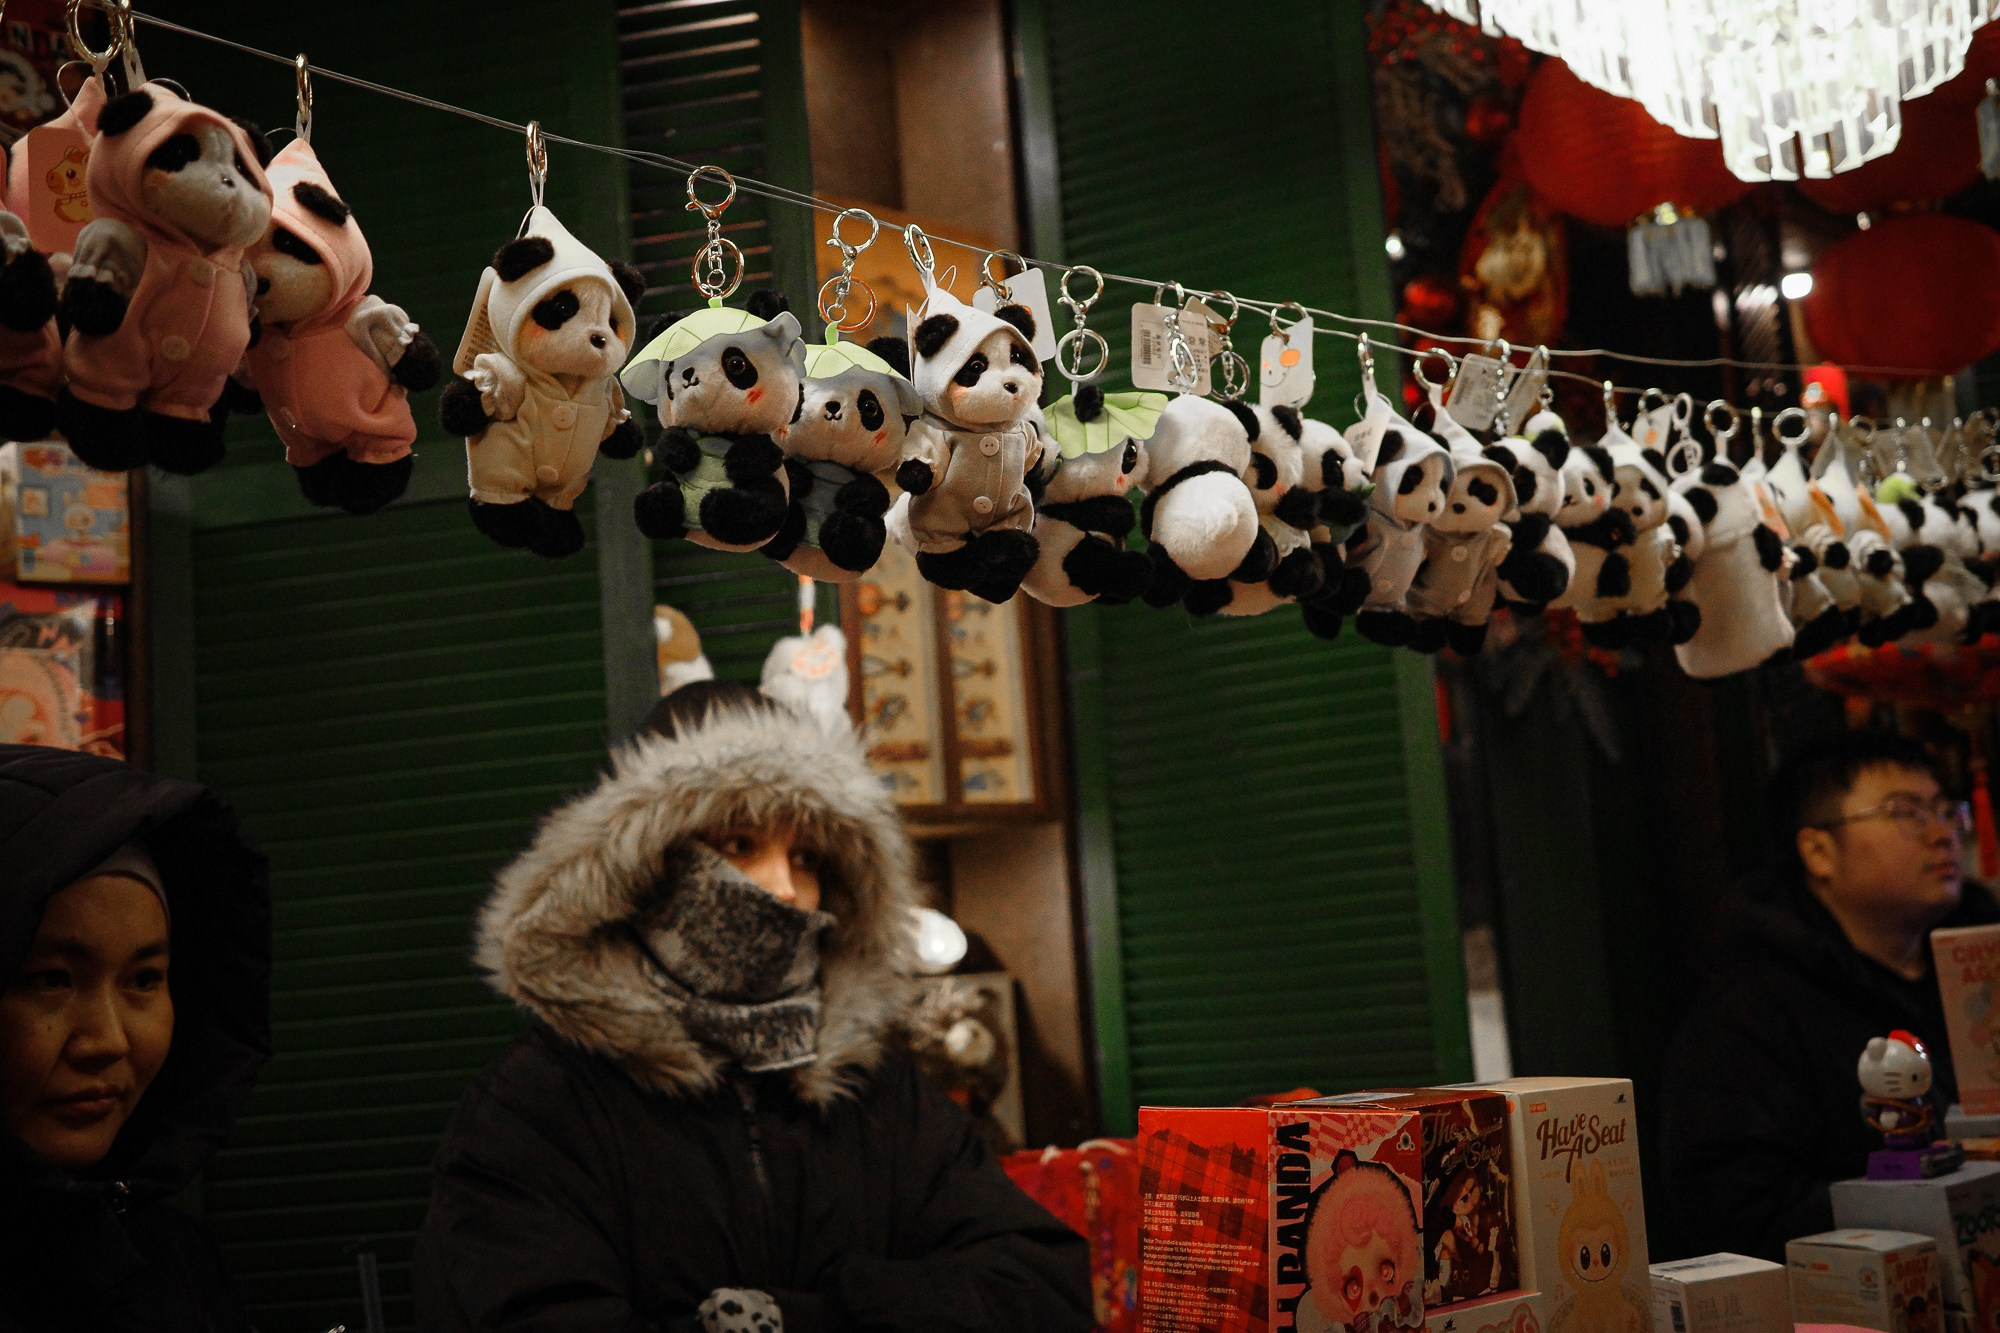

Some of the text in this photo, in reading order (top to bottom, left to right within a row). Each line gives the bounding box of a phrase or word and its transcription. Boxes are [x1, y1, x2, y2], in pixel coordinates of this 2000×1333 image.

[1536, 1113, 1586, 1160] Have
[1552, 1114, 1627, 1184] A Seat
